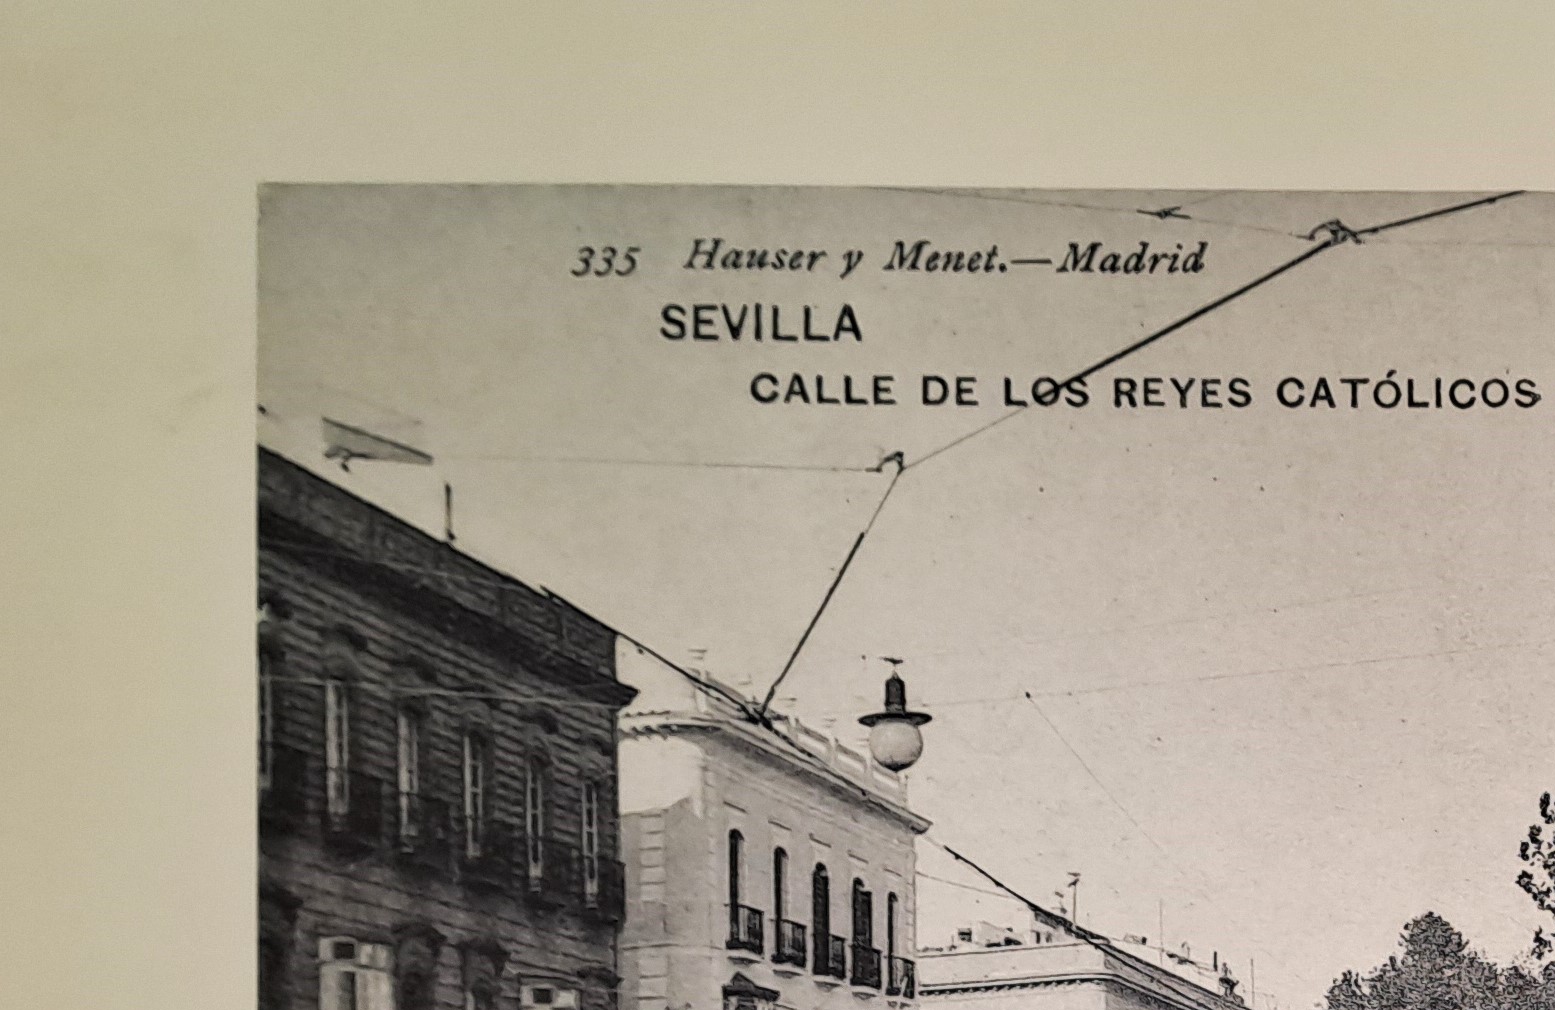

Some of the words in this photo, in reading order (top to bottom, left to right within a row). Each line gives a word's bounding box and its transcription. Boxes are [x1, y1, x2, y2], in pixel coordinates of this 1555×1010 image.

[570, 246, 642, 278] 335
[682, 237, 828, 273] Hauser
[840, 249, 865, 281] y
[659, 302, 864, 344] SEVILLA
[749, 371, 898, 407] CALLE
[920, 374, 980, 408] DE
[1003, 376, 1090, 409] LOS
[1113, 377, 1254, 410] REYES
[1275, 369, 1542, 411] CATÓLICOS
